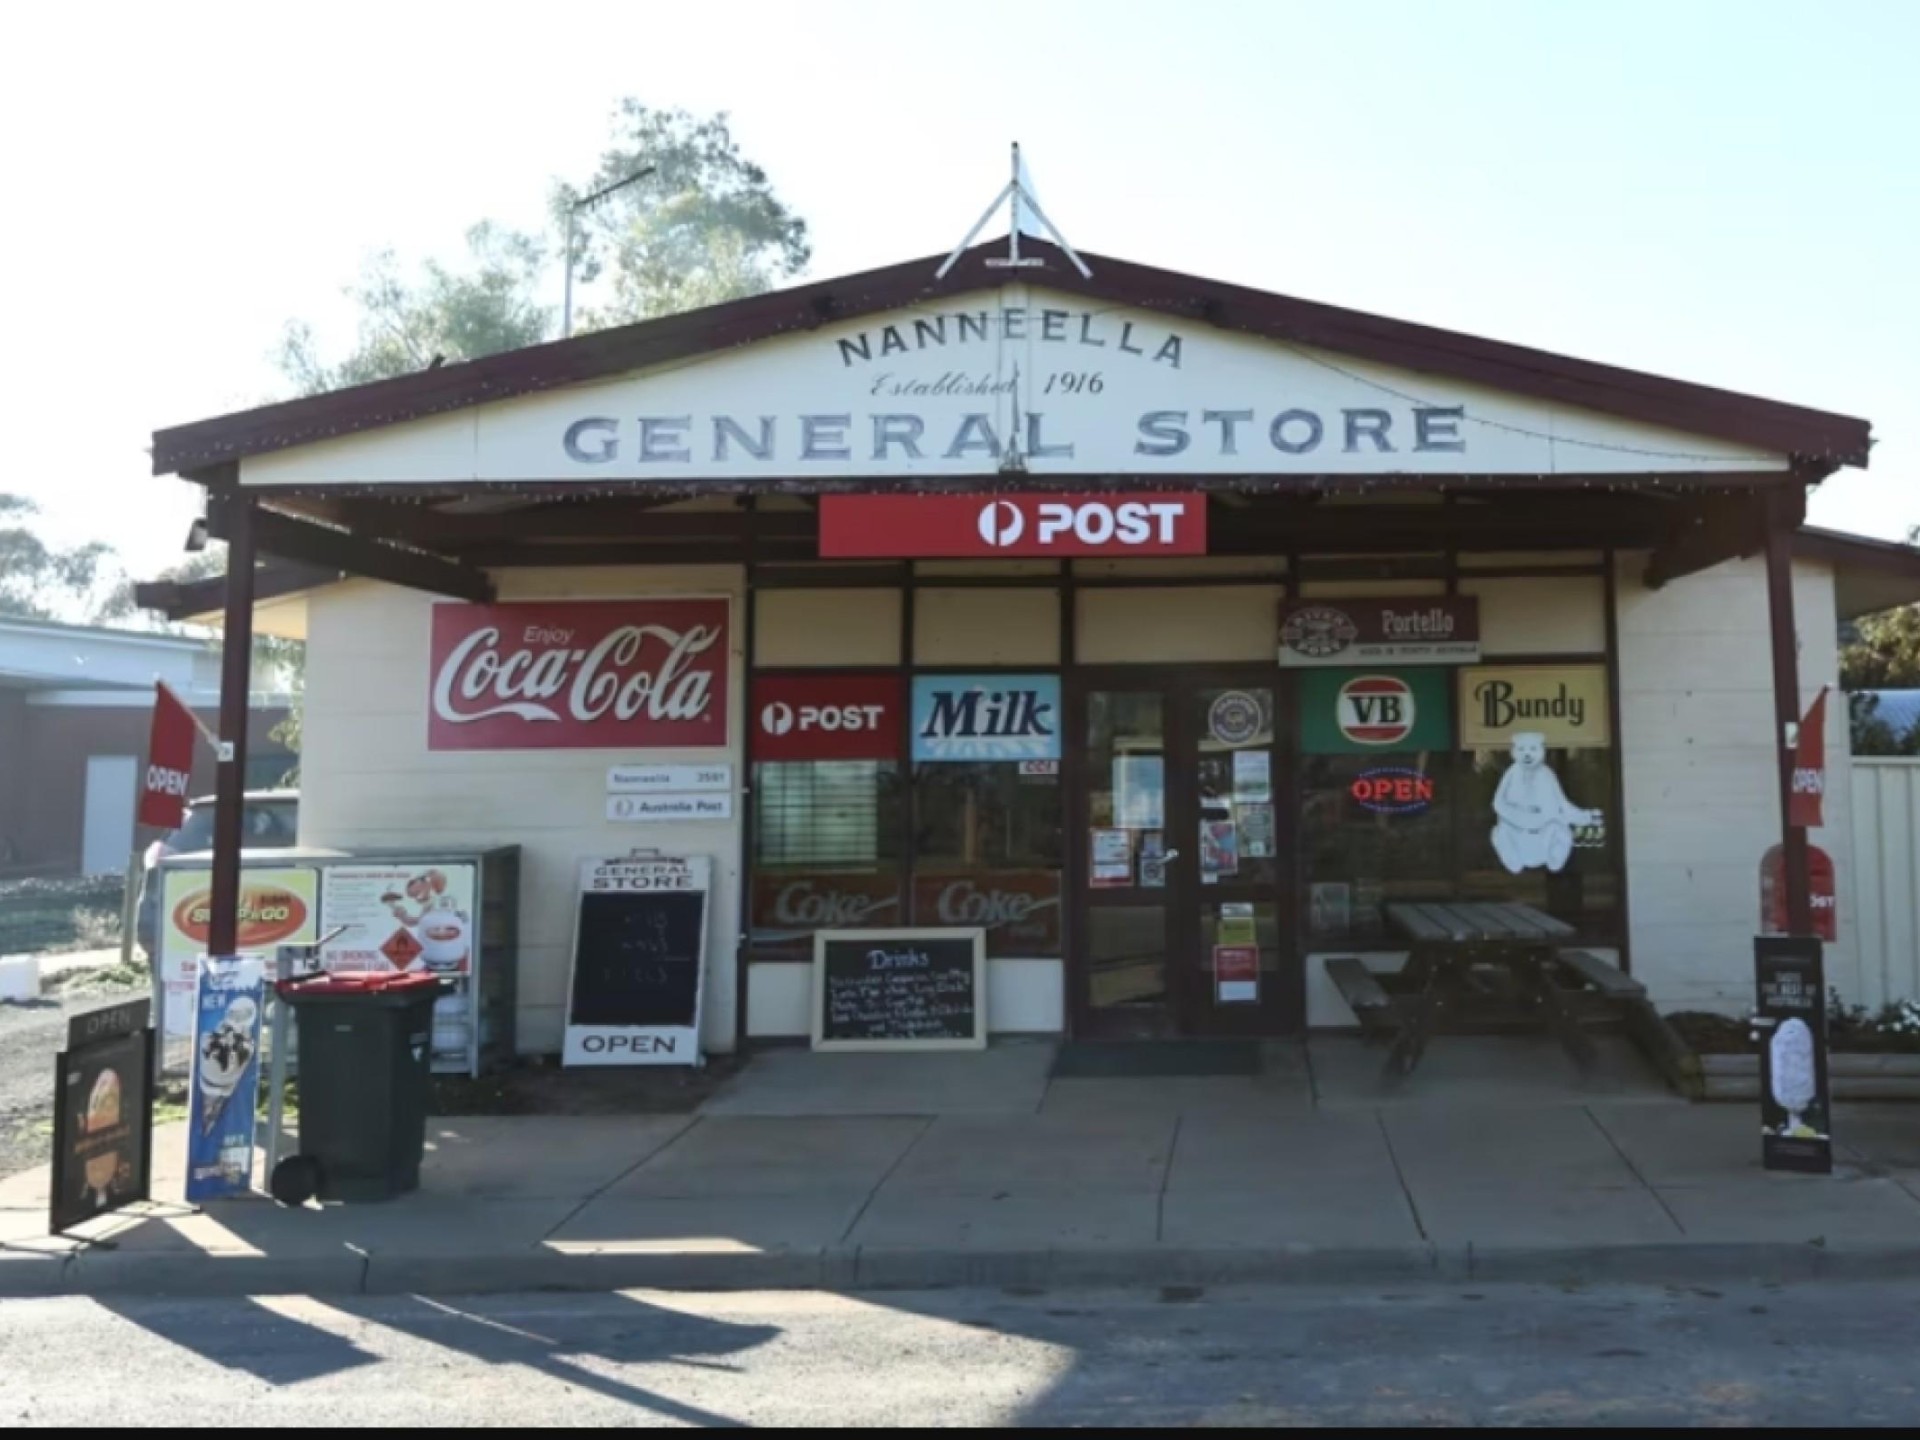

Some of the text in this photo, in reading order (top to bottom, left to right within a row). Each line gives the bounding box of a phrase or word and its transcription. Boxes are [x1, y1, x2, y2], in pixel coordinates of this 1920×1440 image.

[836, 308, 1183, 368] NANNEELLA
[870, 371, 1105, 397] Established 1916
[562, 404, 1467, 464] GENERAL STORE
[1038, 502, 1184, 545] POST
[1381, 608, 1454, 634] Portello
[522, 626, 575, 645] Enjoy
[433, 625, 722, 723] Coca-Cola
[920, 690, 1054, 738] Milk
[1347, 695, 1403, 724] VB
[1474, 679, 1585, 728] Bundy
[798, 705, 885, 731] POST
[146, 766, 190, 796] OPEN
[1352, 778, 1434, 801] OPEN
[1793, 768, 1825, 793] OPEN
[640, 799, 723, 813] Australia Post
[593, 876, 692, 889] STORE
[594, 866, 693, 877] GENERAL
[775, 881, 872, 924] Coke
[937, 881, 1036, 925] Coke
[866, 948, 930, 970] Drinks
[87, 1009, 131, 1035] OPEN
[583, 1034, 676, 1053] OPEN
